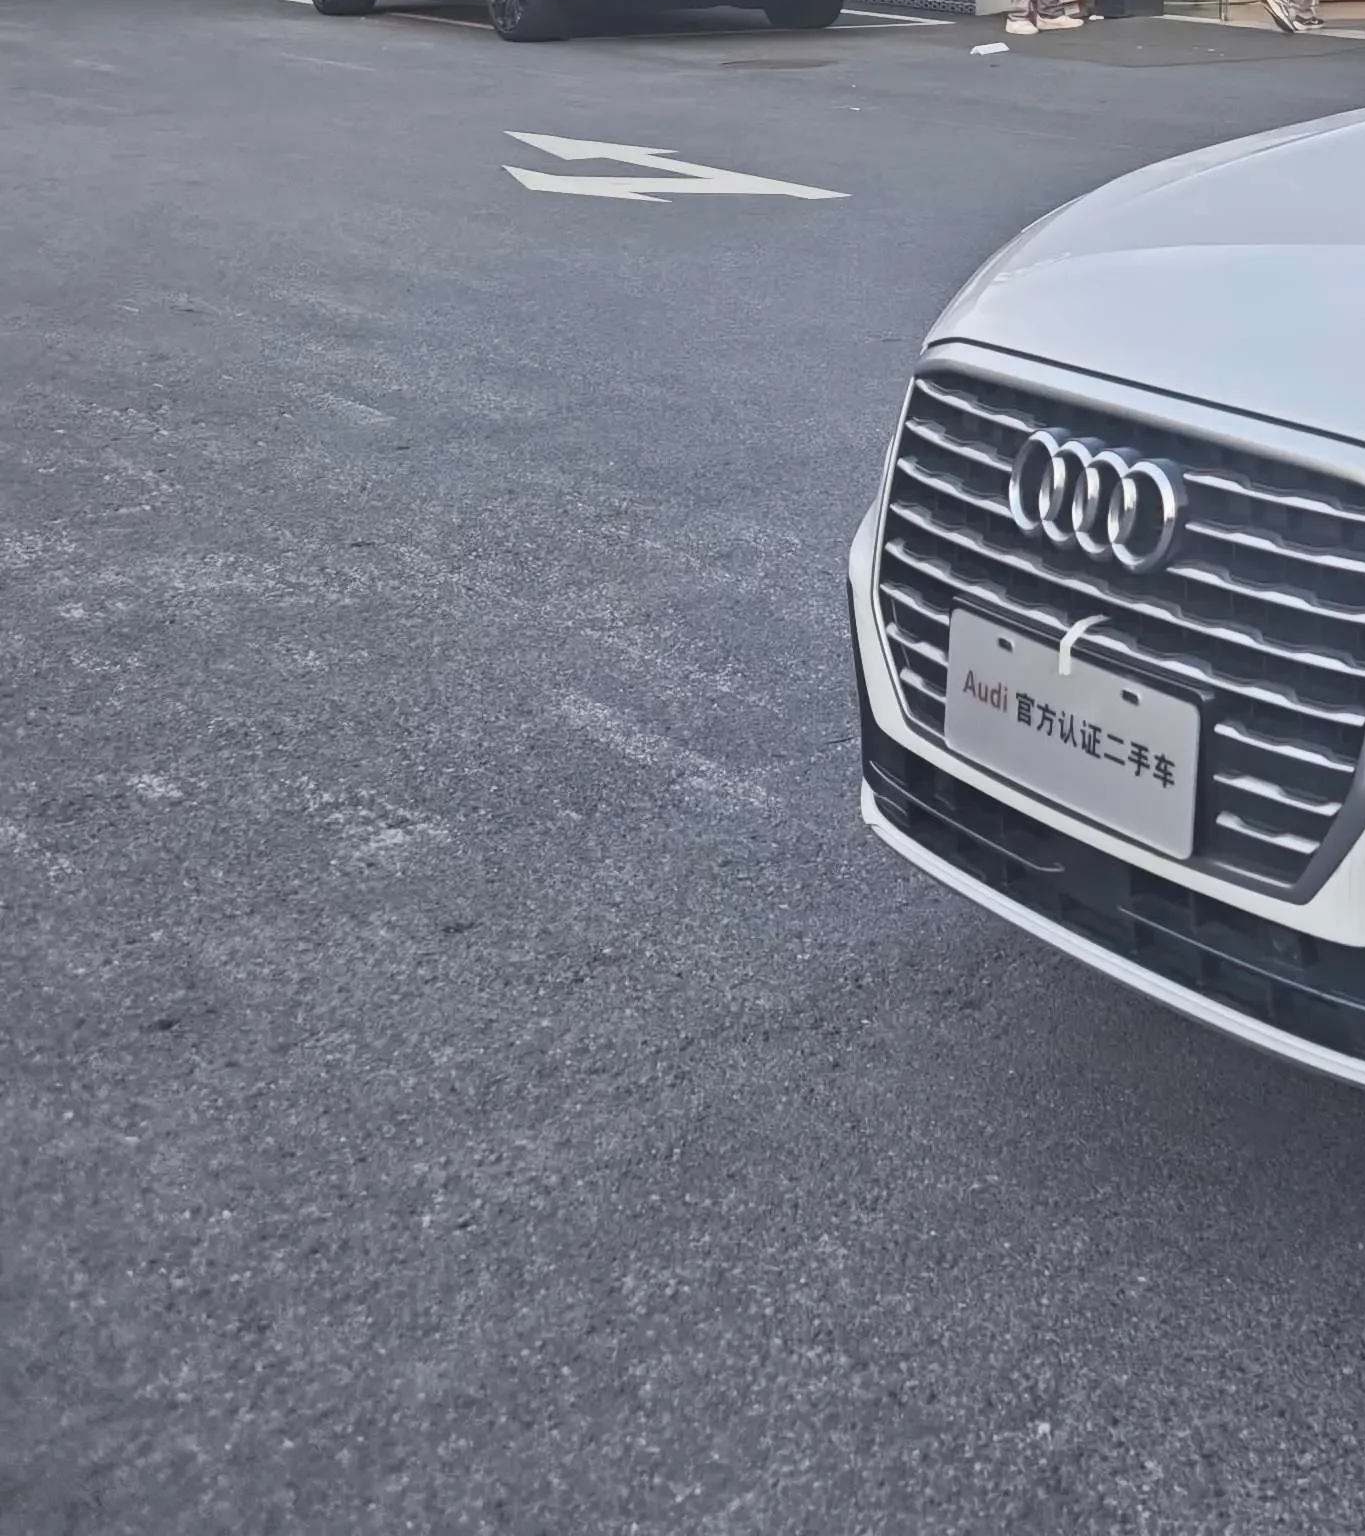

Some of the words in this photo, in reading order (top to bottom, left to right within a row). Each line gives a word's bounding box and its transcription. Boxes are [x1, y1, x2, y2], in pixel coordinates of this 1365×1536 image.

[962, 669, 1008, 713] Audi
[1015, 692, 1176, 789] 官方认证二手车
